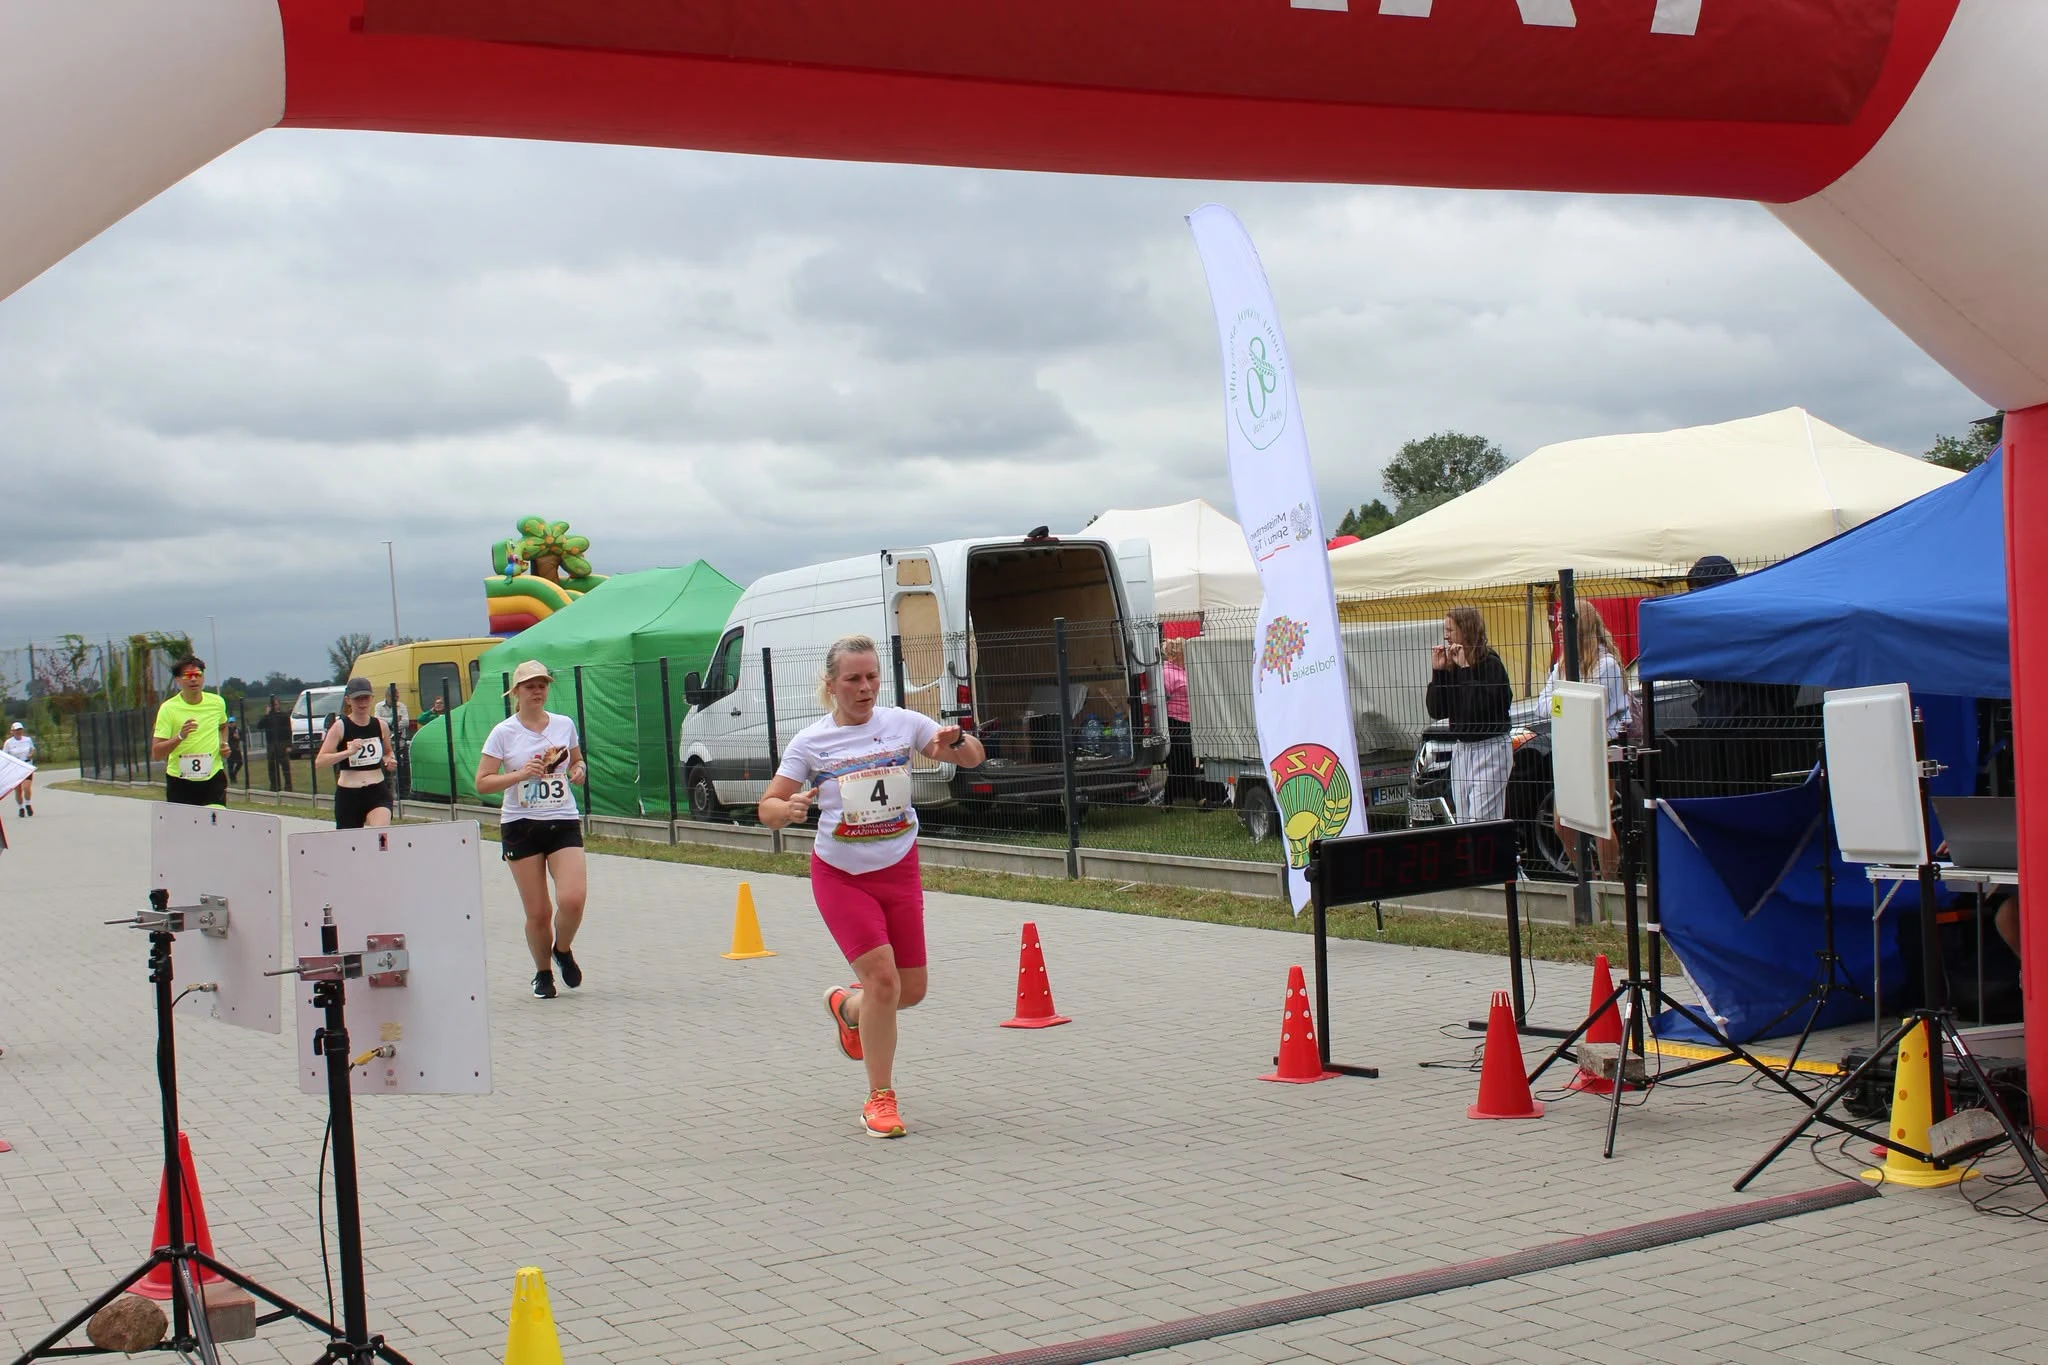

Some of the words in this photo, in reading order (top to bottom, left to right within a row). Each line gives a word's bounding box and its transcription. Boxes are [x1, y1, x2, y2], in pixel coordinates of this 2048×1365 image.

[358, 743, 376, 759] 29
[192, 759, 201, 772] 8
[523, 780, 565, 800] 03
[870, 779, 889, 806] 4
